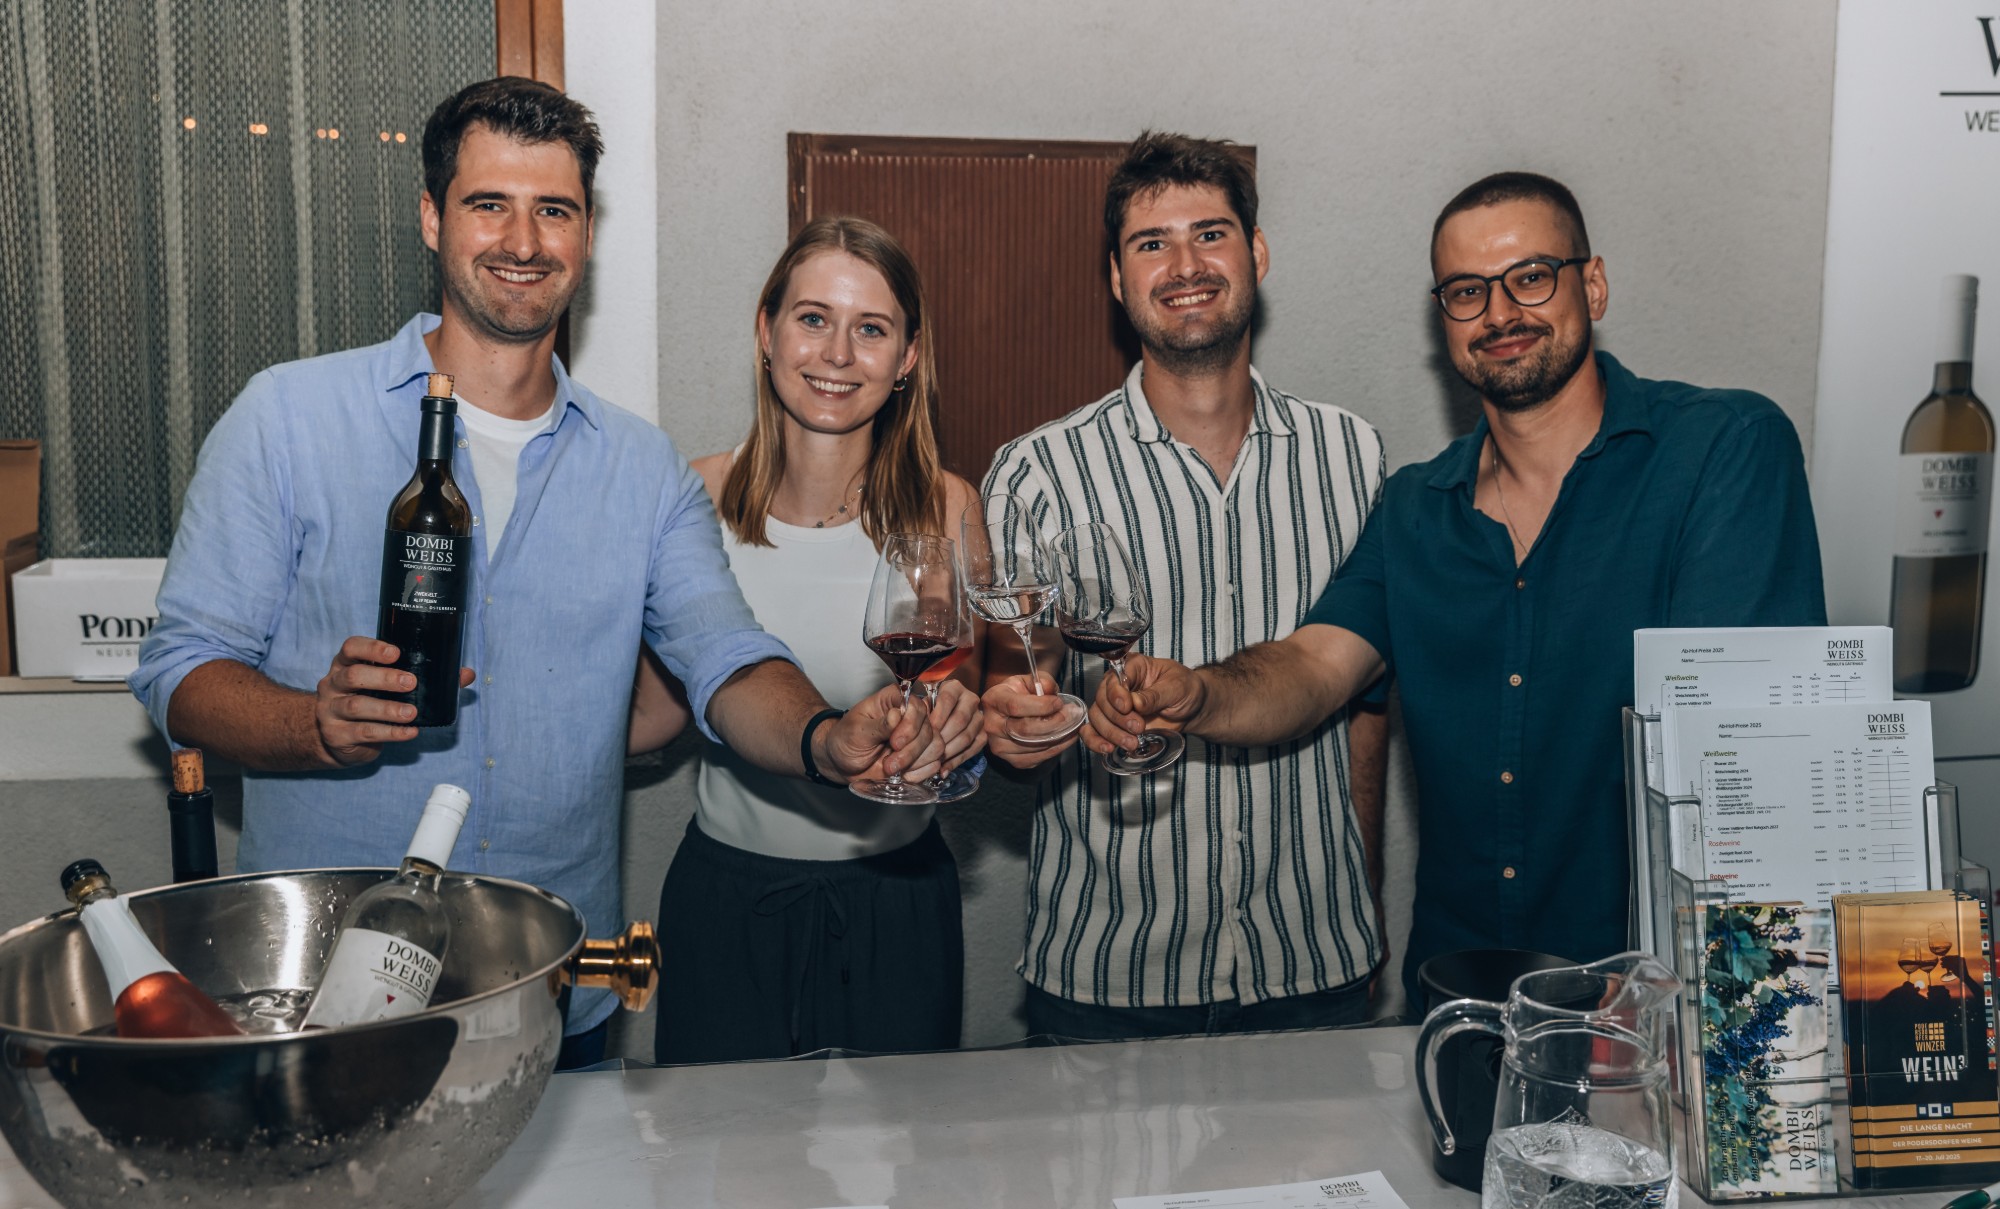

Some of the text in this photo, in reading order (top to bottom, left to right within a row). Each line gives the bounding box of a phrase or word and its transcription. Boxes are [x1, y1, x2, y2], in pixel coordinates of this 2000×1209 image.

[406, 535, 454, 551] DOMBI
[406, 549, 453, 563] WEISS
[1827, 640, 1863, 649] DOMBI
[1827, 650, 1864, 659] WEISS
[1867, 713, 1904, 723] DOMBI
[1868, 724, 1905, 733] WEISS
[387, 941, 436, 977] DOMBI
[383, 956, 431, 993] WEISS
[1915, 1041, 1945, 1052] WINZER
[1945, 1122, 1973, 1130] NACHT
[1786, 1110, 1802, 1171] DOMBI
[1801, 1110, 1817, 1171] WEISS
[1907, 1138, 1960, 1146] PODERSDORFER
[1320, 1181, 1359, 1190] DOMBI
[1323, 1187, 1364, 1195] WEISS
